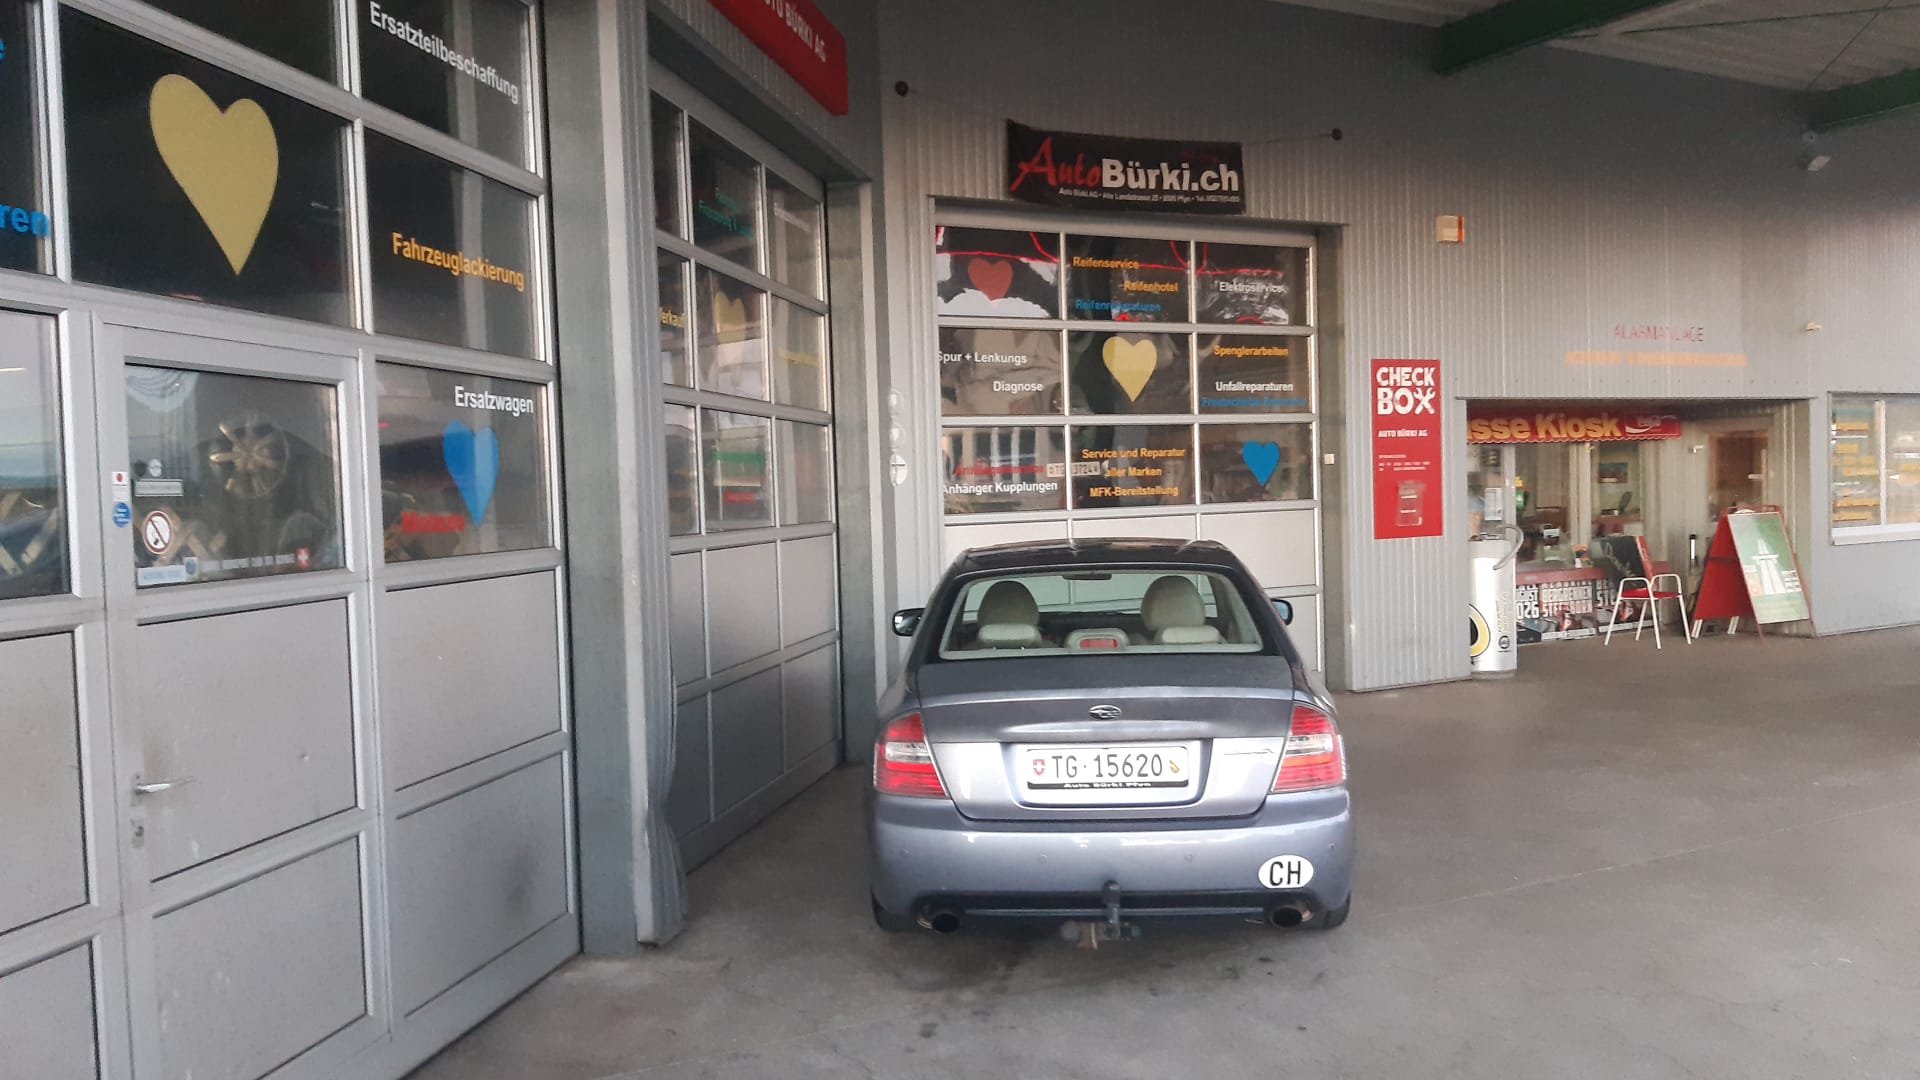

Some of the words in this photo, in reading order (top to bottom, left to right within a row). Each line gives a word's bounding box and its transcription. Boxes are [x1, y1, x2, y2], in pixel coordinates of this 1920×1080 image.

[370, 1, 519, 104] Ersatzteilbeschaffung
[392, 232, 524, 292] Fahrzeuglackierung
[1073, 256, 1139, 269] Reifenservice
[1124, 280, 1179, 292] Reifenhotel
[938, 351, 963, 364] Spur
[974, 351, 1028, 366] Lenkungs
[1376, 366, 1435, 387] CHECK
[993, 381, 1043, 393] Diagnose
[1215, 381, 1294, 393] Unfallreparaturen
[455, 386, 534, 417] Ersatzwagen
[1377, 387, 1435, 415] BOX
[1535, 412, 1622, 438] Kiosk
[1378, 429, 1396, 438] AUTO
[1418, 429, 1428, 437] AG
[1082, 449, 1118, 459] Service
[1120, 449, 1138, 458] und
[1141, 448, 1186, 459] Reparatur
[1105, 467, 1126, 477] aller
[1128, 467, 1162, 477] Marken
[943, 482, 992, 496] Anhänger
[994, 481, 1058, 495] Kupplungen
[1089, 486, 1179, 498] MFK-Bereitstellung
[1269, 861, 1301, 886] CH
